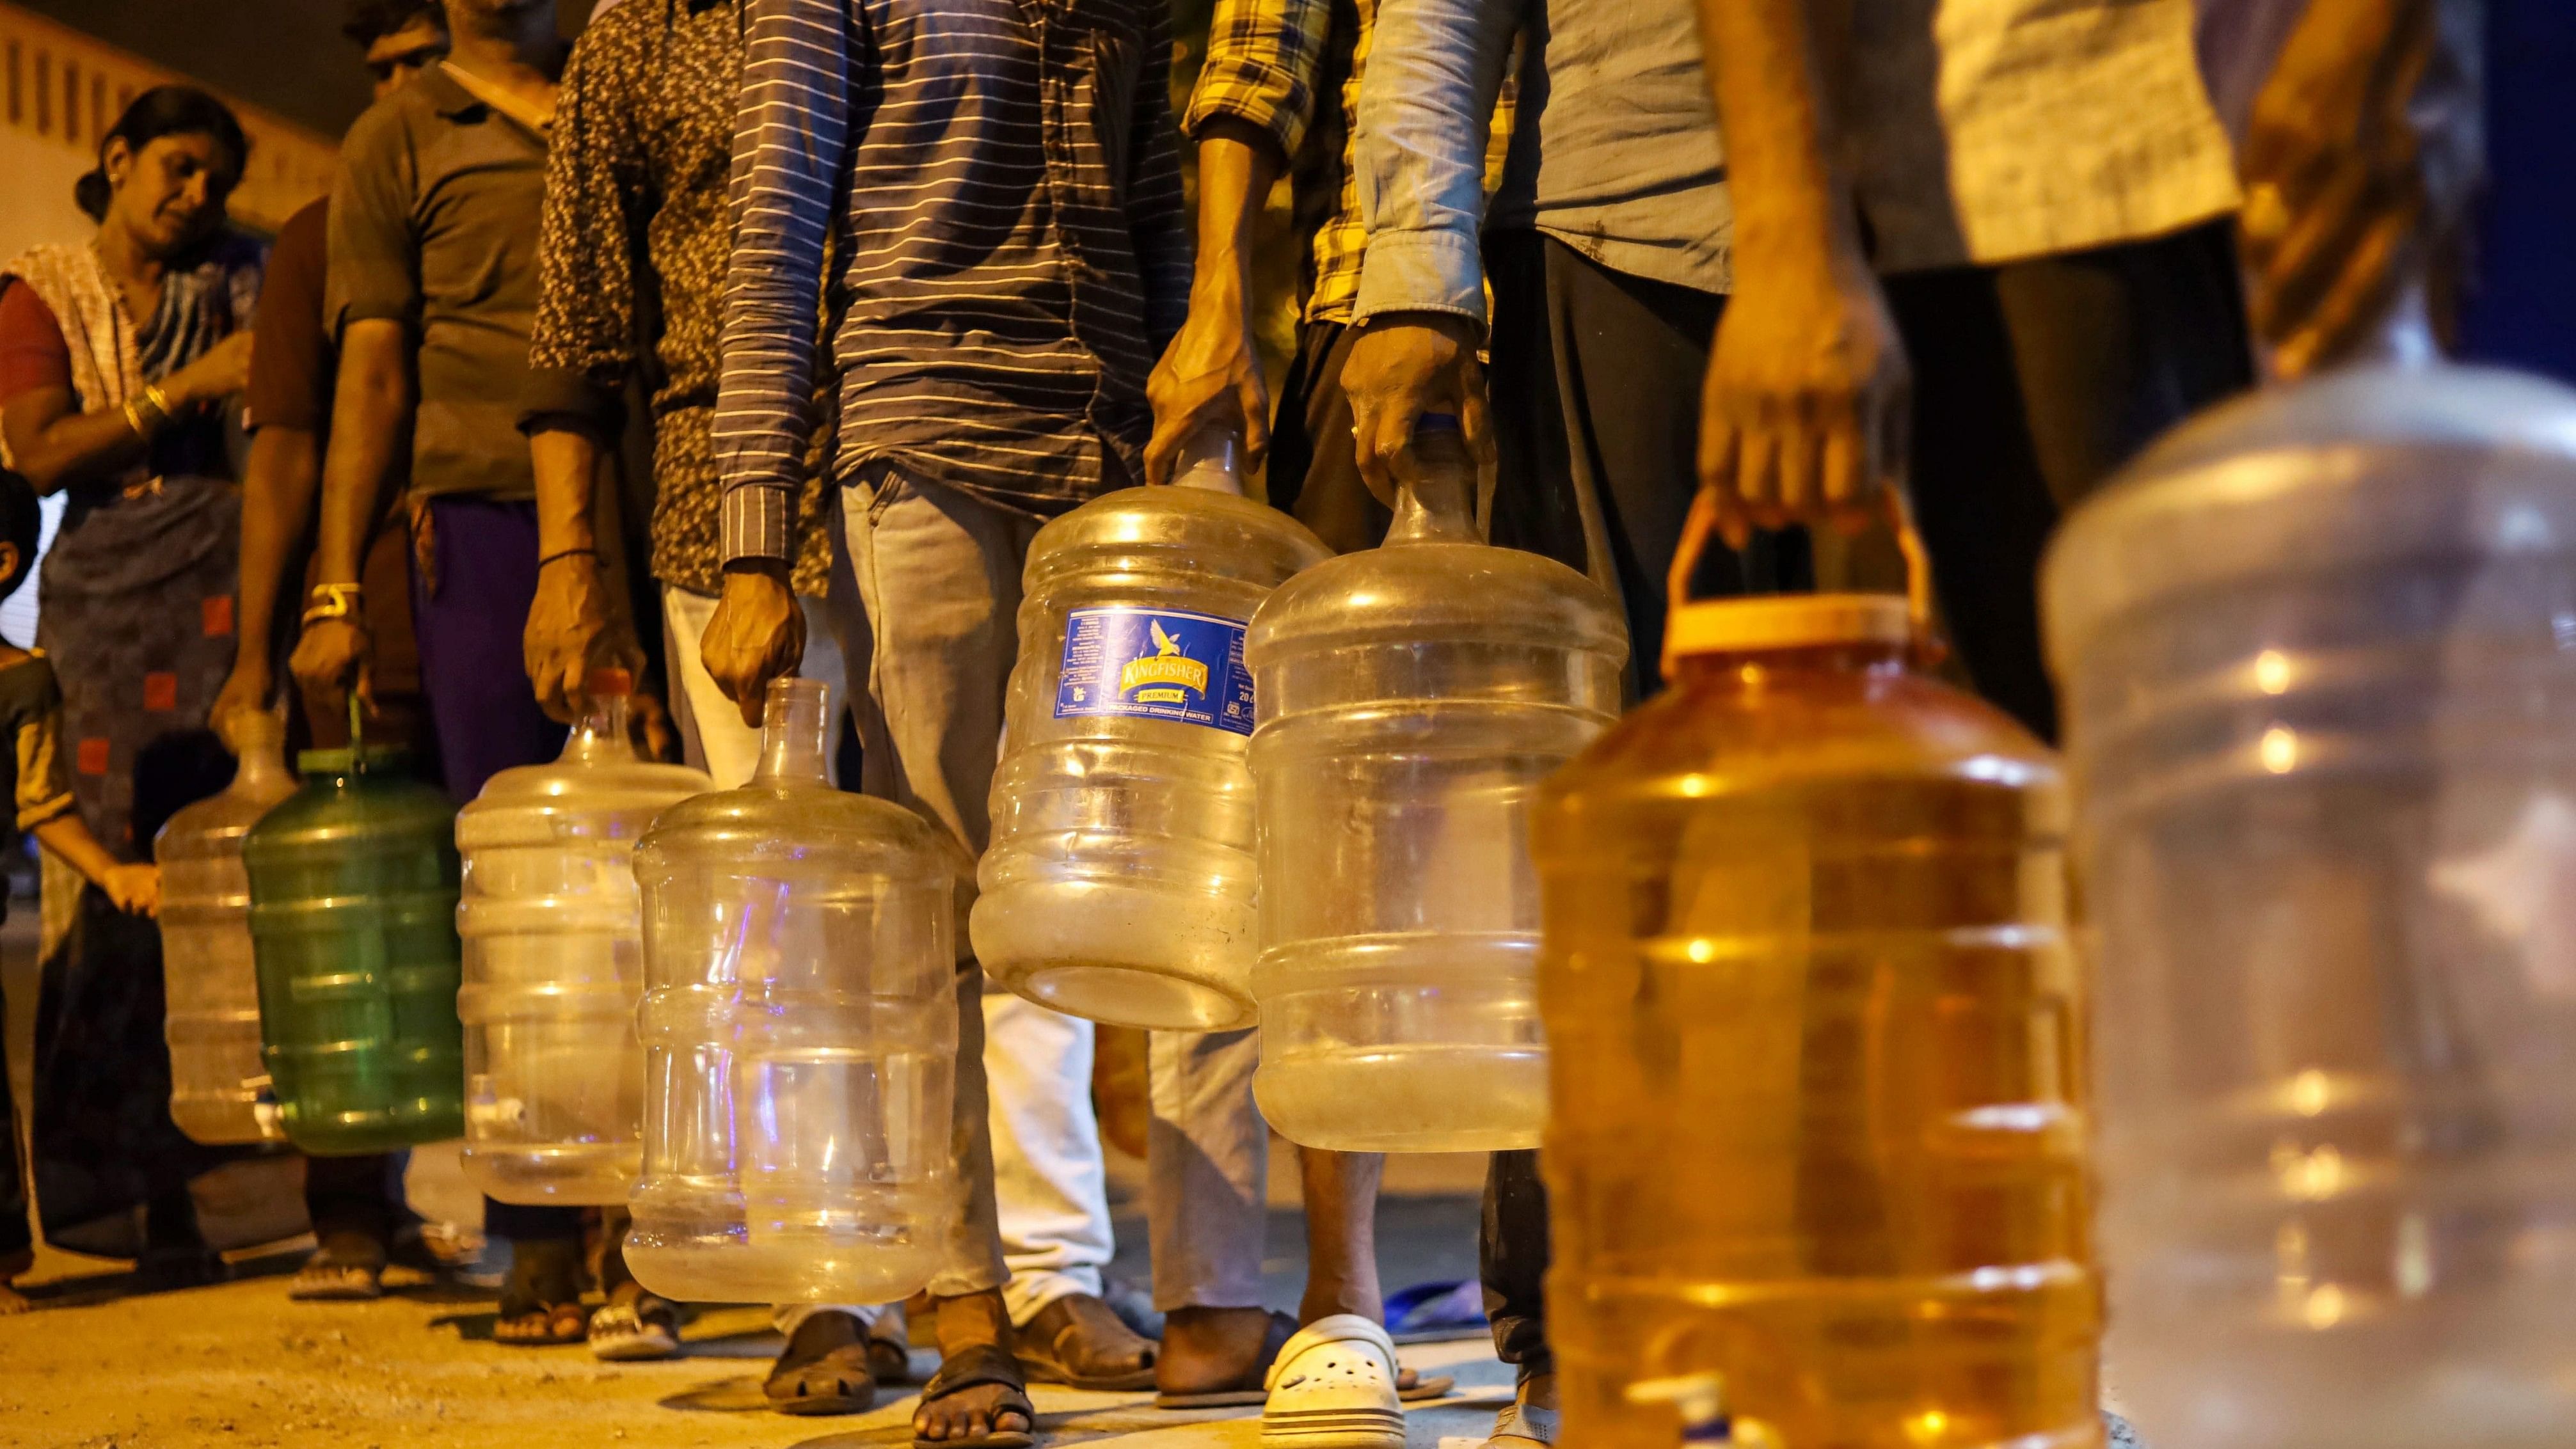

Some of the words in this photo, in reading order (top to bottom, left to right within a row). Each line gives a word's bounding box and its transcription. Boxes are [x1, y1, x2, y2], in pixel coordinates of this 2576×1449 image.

[1124, 663, 1203, 686] KINGFISHER
[1141, 691, 1179, 700] PREMIUM
[1239, 692, 1249, 702] 20
[1149, 707, 1185, 717] DRINKING
[1186, 711, 1211, 721] WATER
